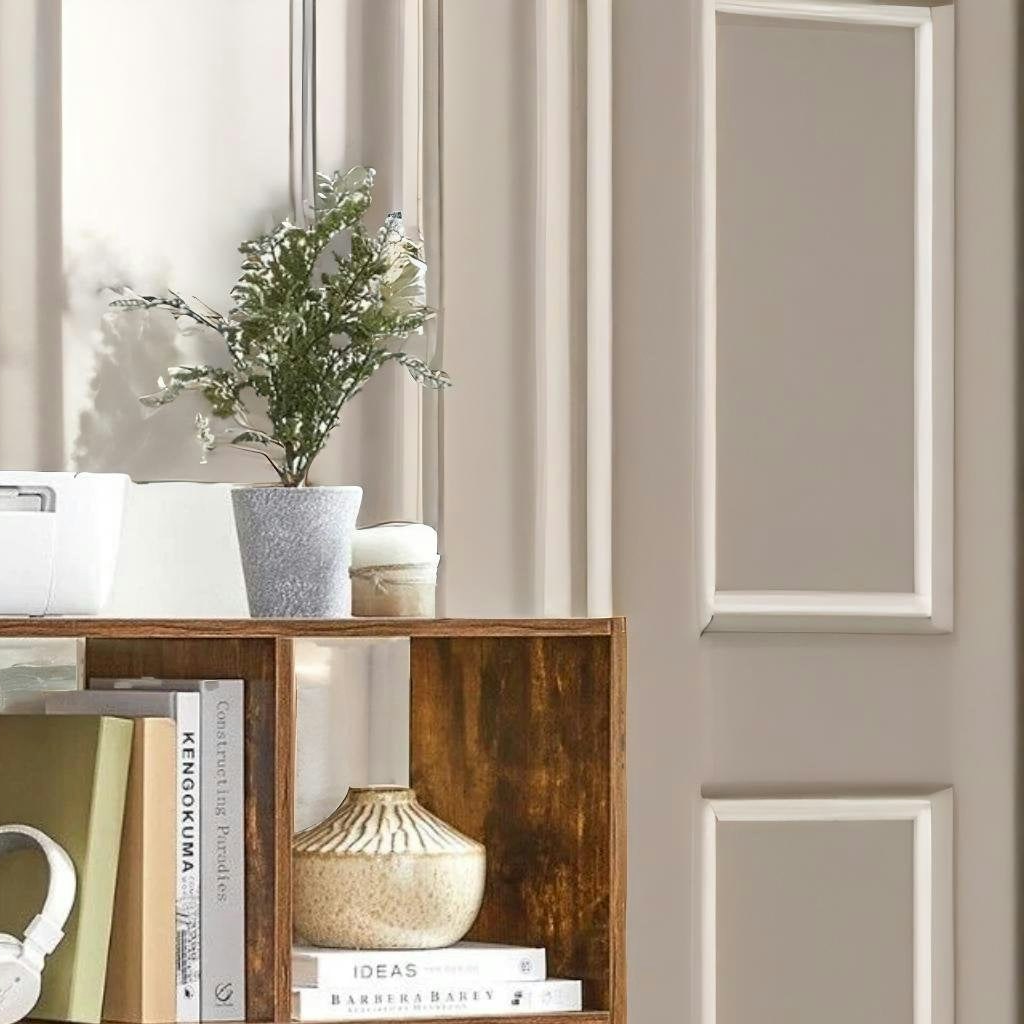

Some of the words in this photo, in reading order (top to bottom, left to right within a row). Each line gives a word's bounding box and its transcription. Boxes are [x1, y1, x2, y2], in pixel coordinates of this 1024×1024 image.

[181, 731, 196, 873] KENGOKUMA
[215, 700, 230, 817] Constructing
[216, 825, 230, 903] Paradies
[353, 963, 418, 979] IDEAS
